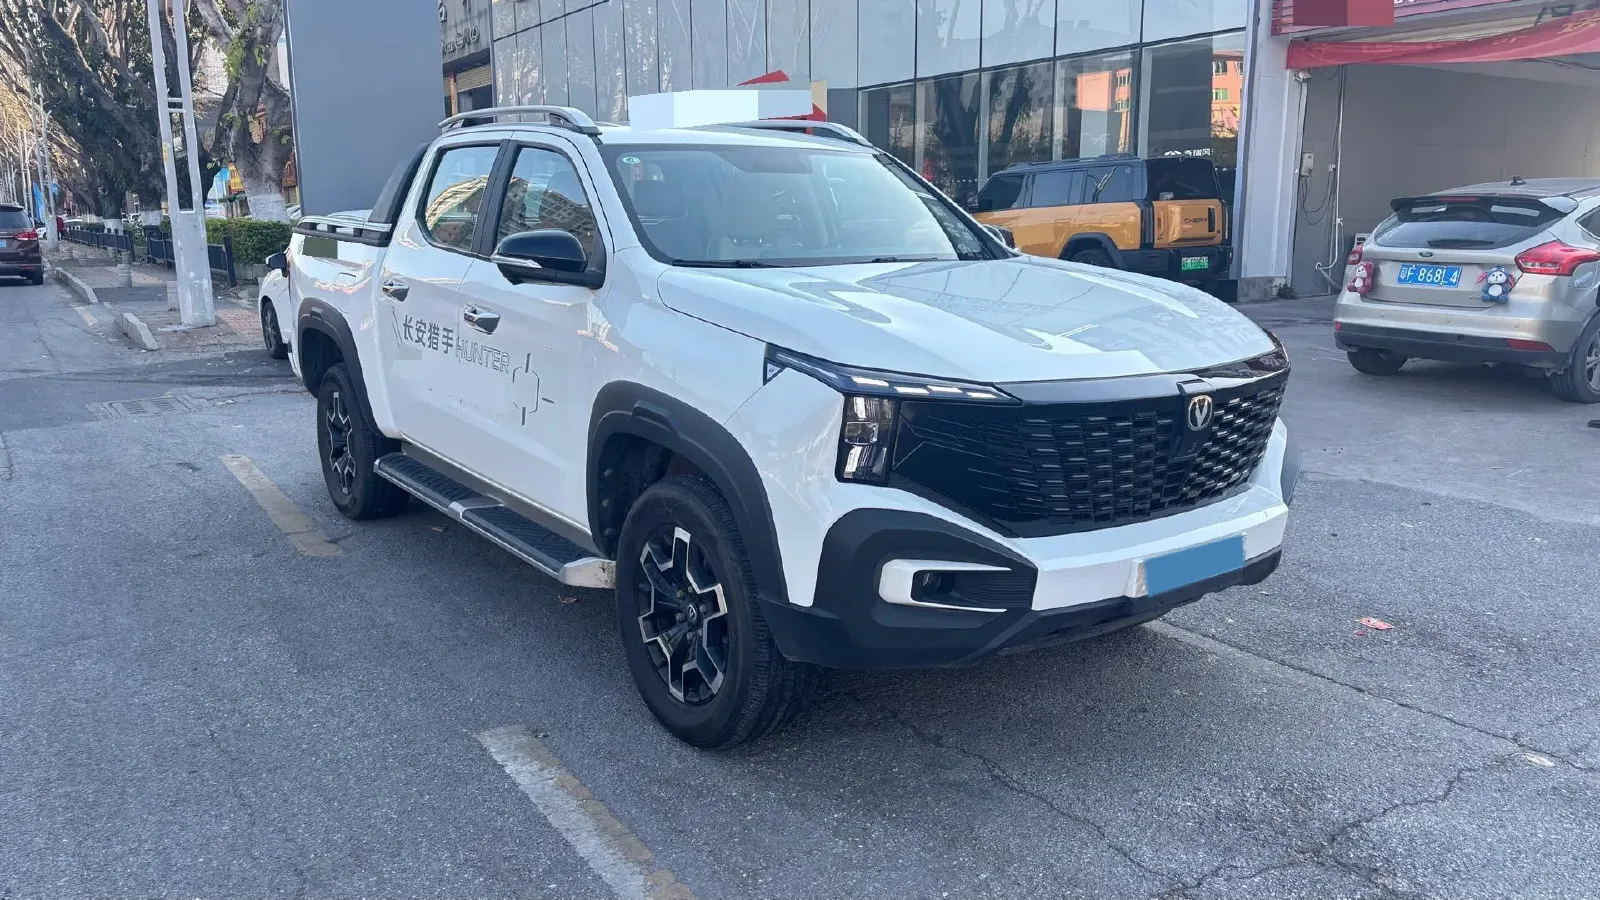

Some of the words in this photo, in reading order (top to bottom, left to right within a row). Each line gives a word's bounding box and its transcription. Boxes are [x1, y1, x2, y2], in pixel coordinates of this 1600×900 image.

[403, 314, 454, 354] 长安猎手
[456, 337, 510, 374] HUNTER
